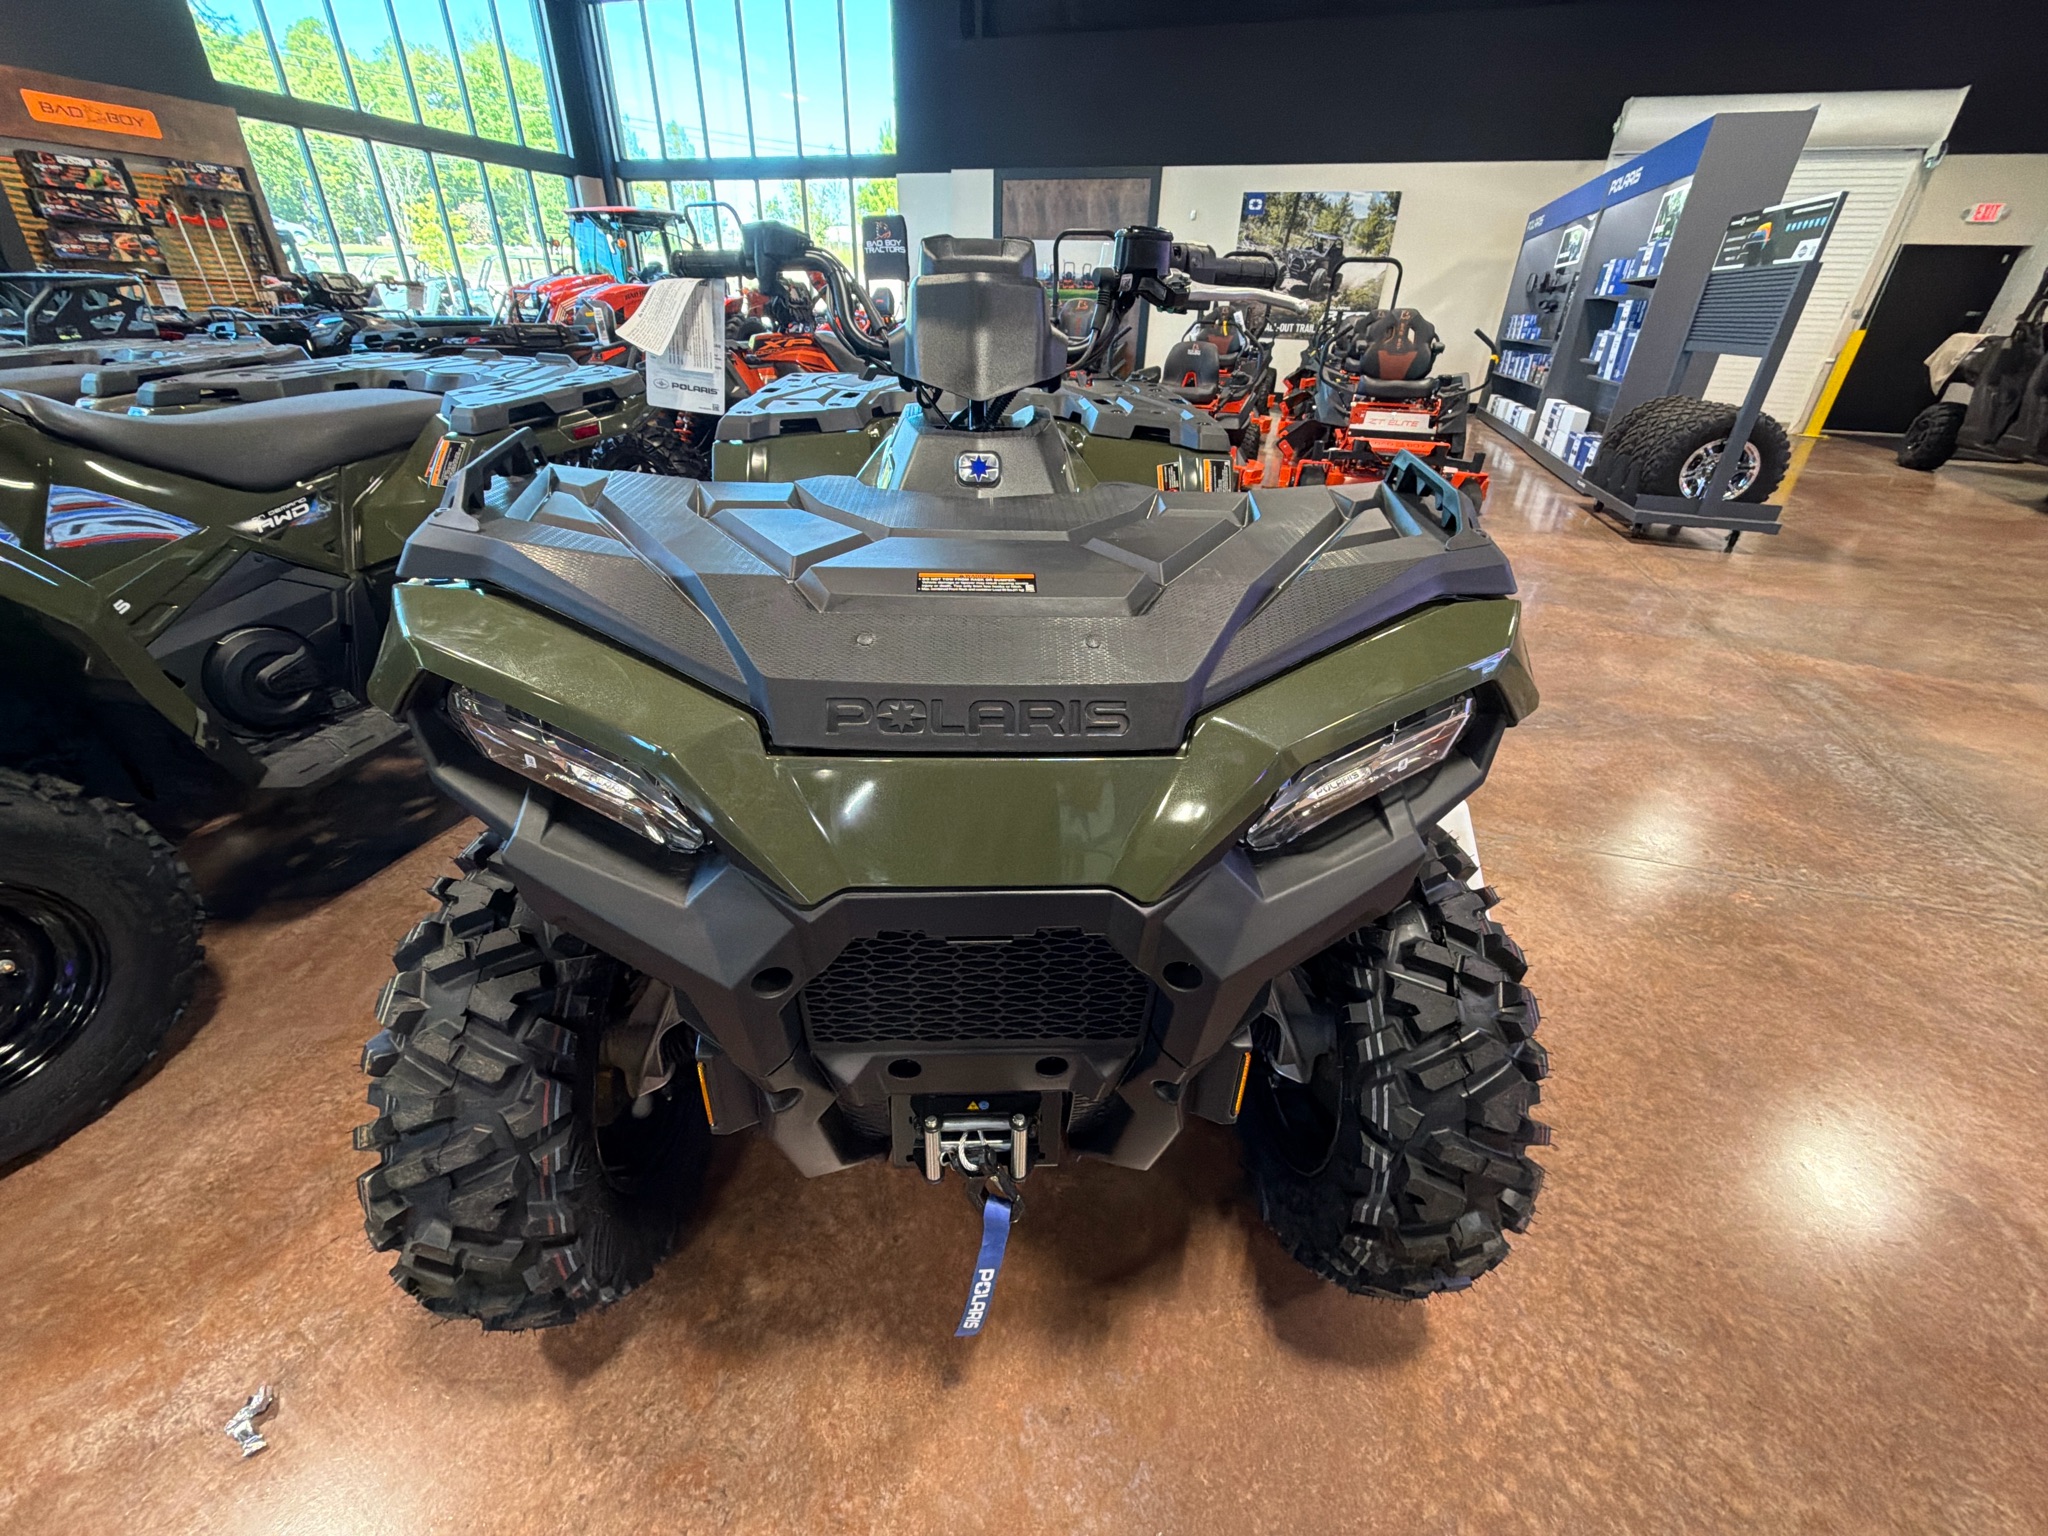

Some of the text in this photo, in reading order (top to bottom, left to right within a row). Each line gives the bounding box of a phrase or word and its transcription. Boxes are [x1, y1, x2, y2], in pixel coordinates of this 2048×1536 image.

[38, 101, 144, 127] BAD BOY
[1608, 166, 1644, 196] POLARIS
[1974, 204, 2003, 221] EXIT
[864, 246, 906, 254] TRACTORS
[866, 239, 902, 248] BAD BOY
[1296, 323, 1316, 333] TRAIL
[760, 338, 813, 351] XP
[671, 382, 718, 395] POLARIS
[1387, 420, 1419, 428] ELITE
[257, 503, 310, 533] AWD
[825, 697, 1131, 737] POLARIS
[963, 1268, 995, 1329] POLARIS
